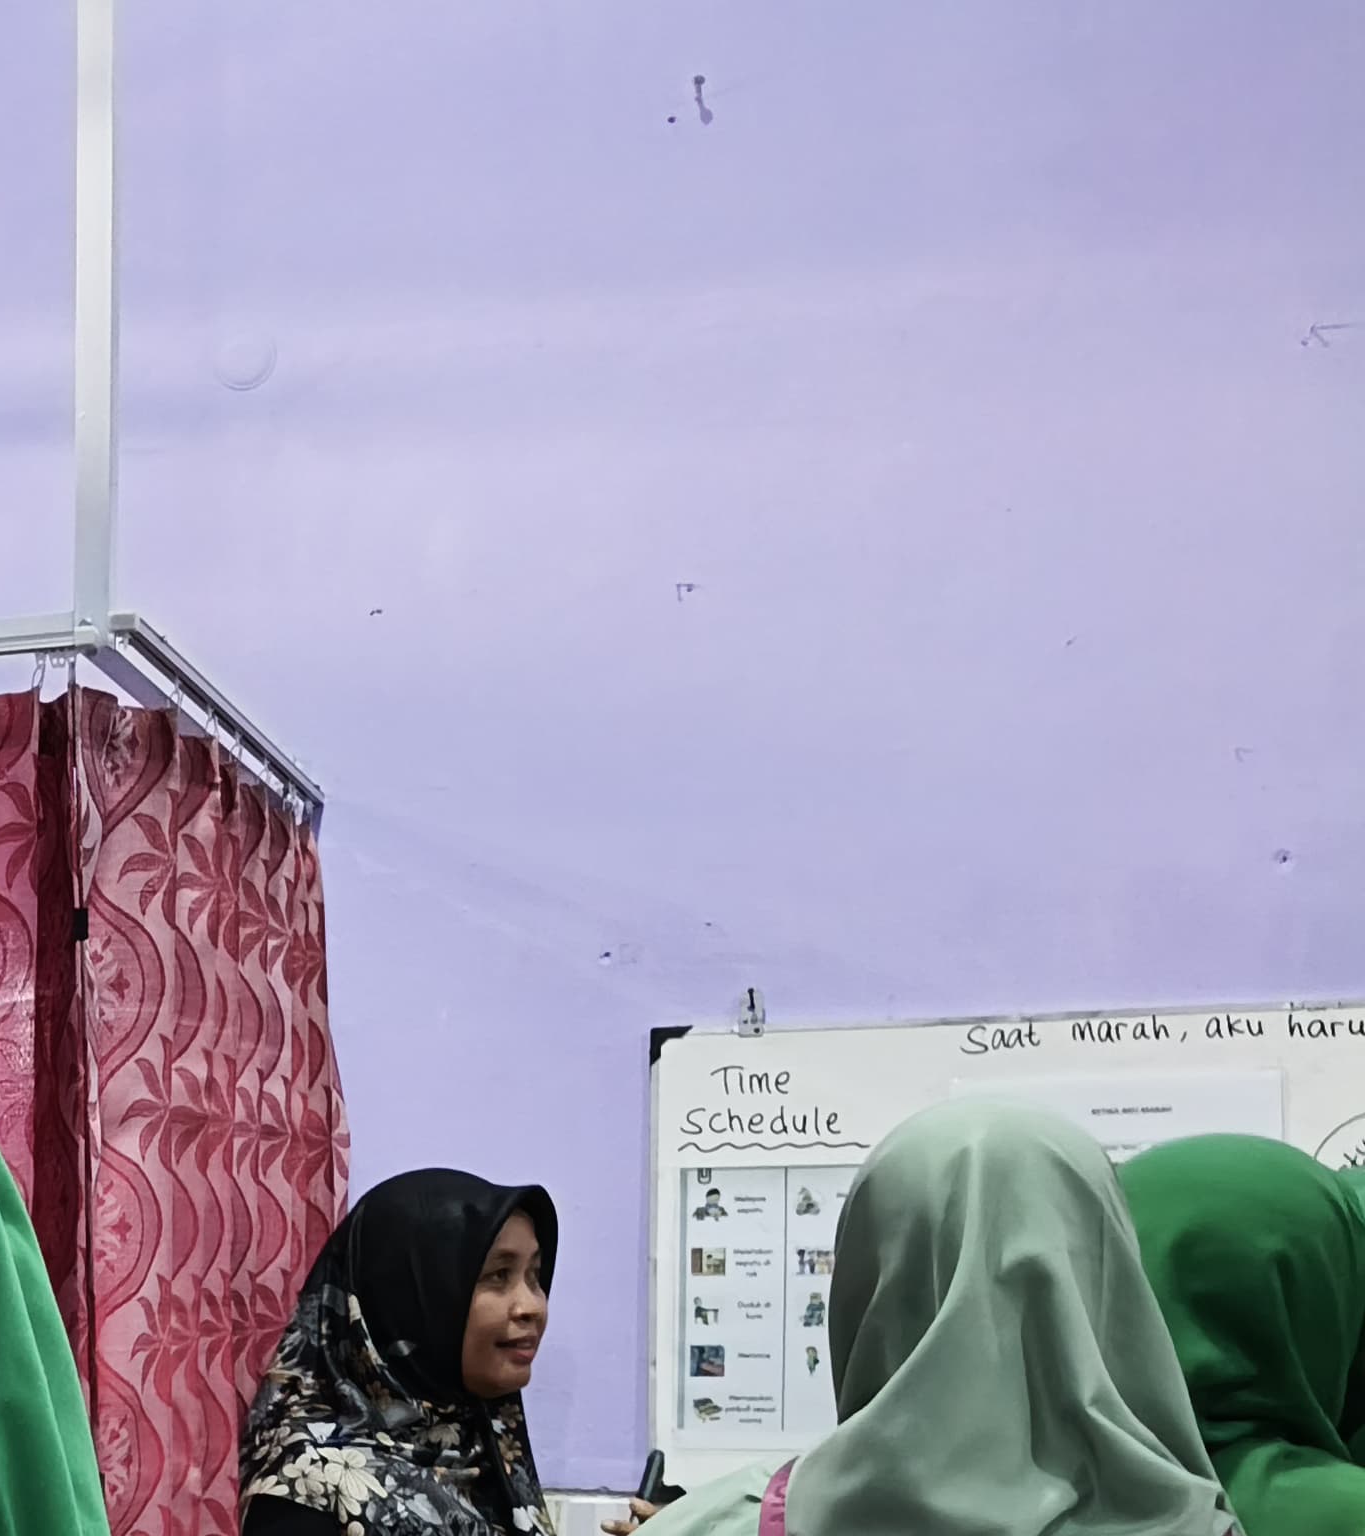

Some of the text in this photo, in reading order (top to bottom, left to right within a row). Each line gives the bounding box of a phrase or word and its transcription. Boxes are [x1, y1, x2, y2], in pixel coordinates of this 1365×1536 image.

[960, 1022, 1041, 1055] Saat
[1204, 1014, 1264, 1039] aku
[710, 1065, 791, 1095] Time
[679, 1105, 842, 1137] Schedule
